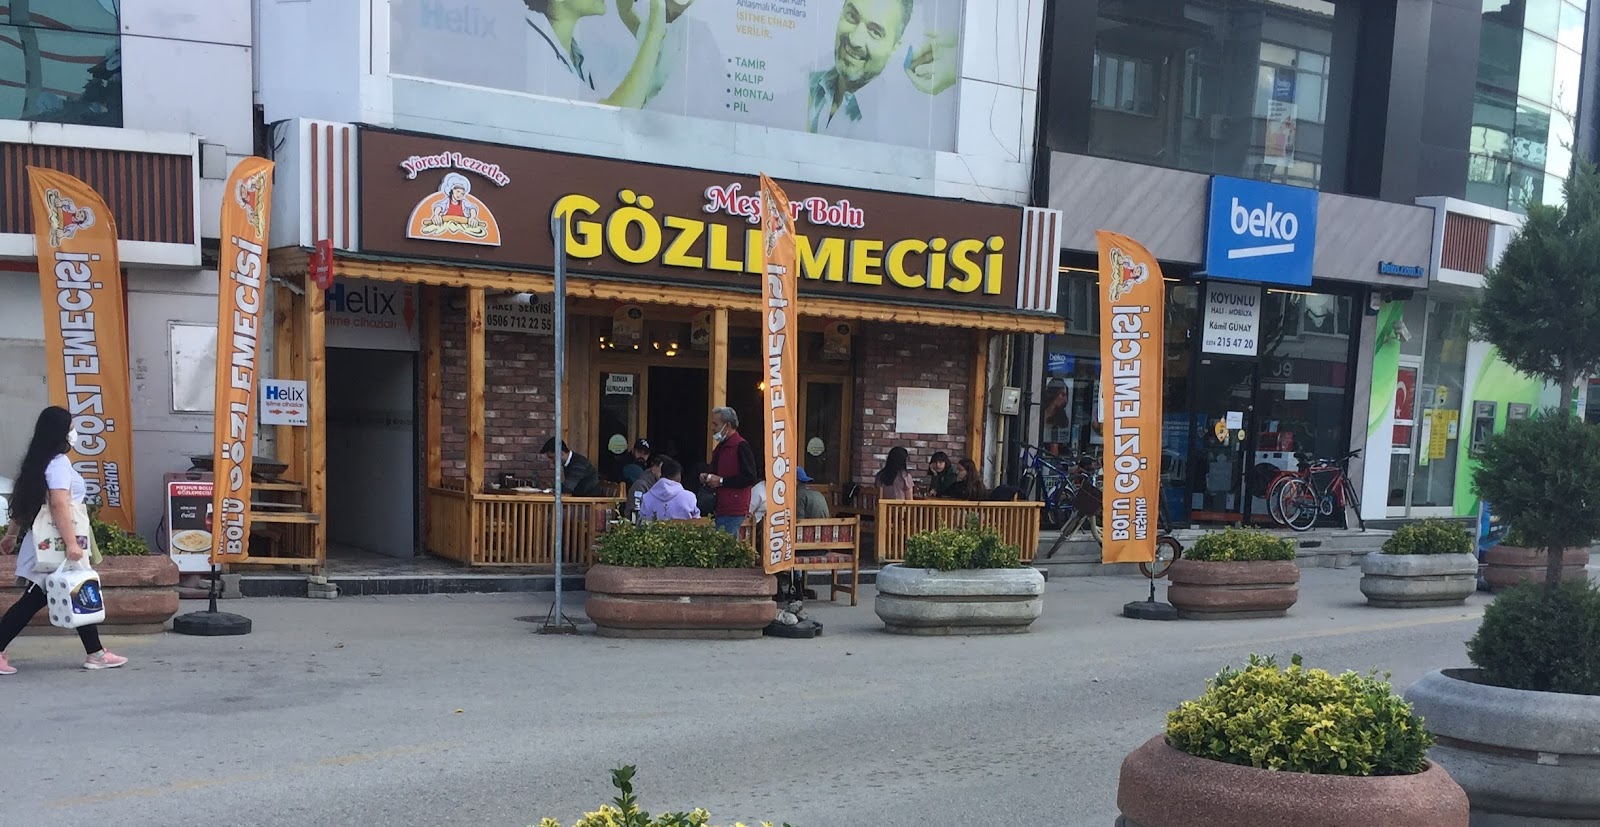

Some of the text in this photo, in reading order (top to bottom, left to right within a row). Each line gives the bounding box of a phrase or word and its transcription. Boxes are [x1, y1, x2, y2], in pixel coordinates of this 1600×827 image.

[770, 3, 807, 18] Kurumlara
[420, 0, 497, 39] Helix
[735, 57, 766, 70] TAMİR
[734, 72, 764, 85] KALIP
[734, 87, 774, 101] MONTAJ
[733, 102, 749, 113] PİL
[401, 152, 511, 187] Yöresel Lezzetler
[704, 183, 865, 229] Meşr Bolu
[1230, 197, 1298, 241] beko
[1379, 261, 1424, 278] beko.com.tr
[325, 283, 397, 316] Helix
[1210, 292, 1256, 307] KOYUNLU
[1211, 307, 1224, 315] HALI
[487, 314, 552, 331] 0506 712 22 55
[1217, 336, 1231, 347] 215
[1232, 338, 1242, 348] 47
[1244, 339, 1254, 349] 20
[1049, 352, 1066, 362] beko
[266, 385, 305, 401] Helix
[226, 498, 246, 554] BOLU
